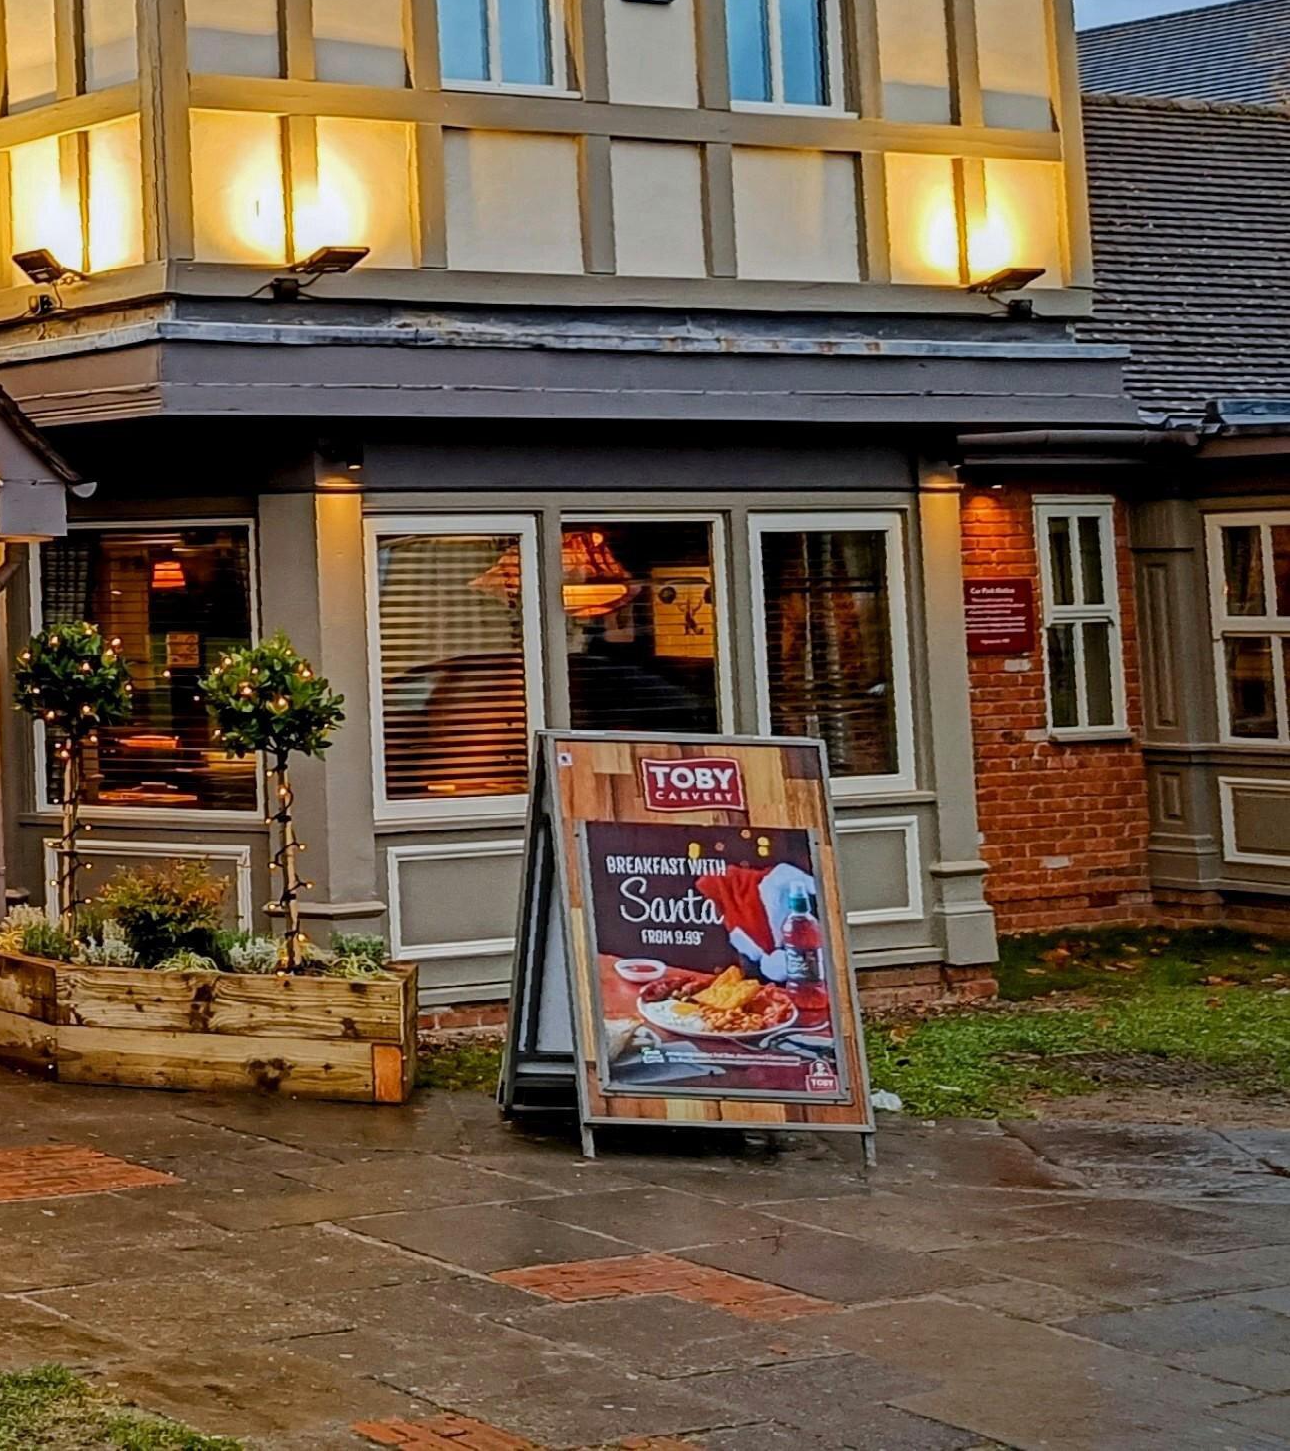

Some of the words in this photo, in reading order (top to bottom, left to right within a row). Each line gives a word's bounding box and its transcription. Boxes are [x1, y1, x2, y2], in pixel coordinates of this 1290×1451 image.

[648, 766, 734, 790] TOBY
[655, 791, 732, 801] CARVERY
[606, 855, 686, 875] BREAKFAST
[687, 858, 726, 876] WITH
[620, 876, 725, 924] Santa
[641, 929, 673, 945] FROM
